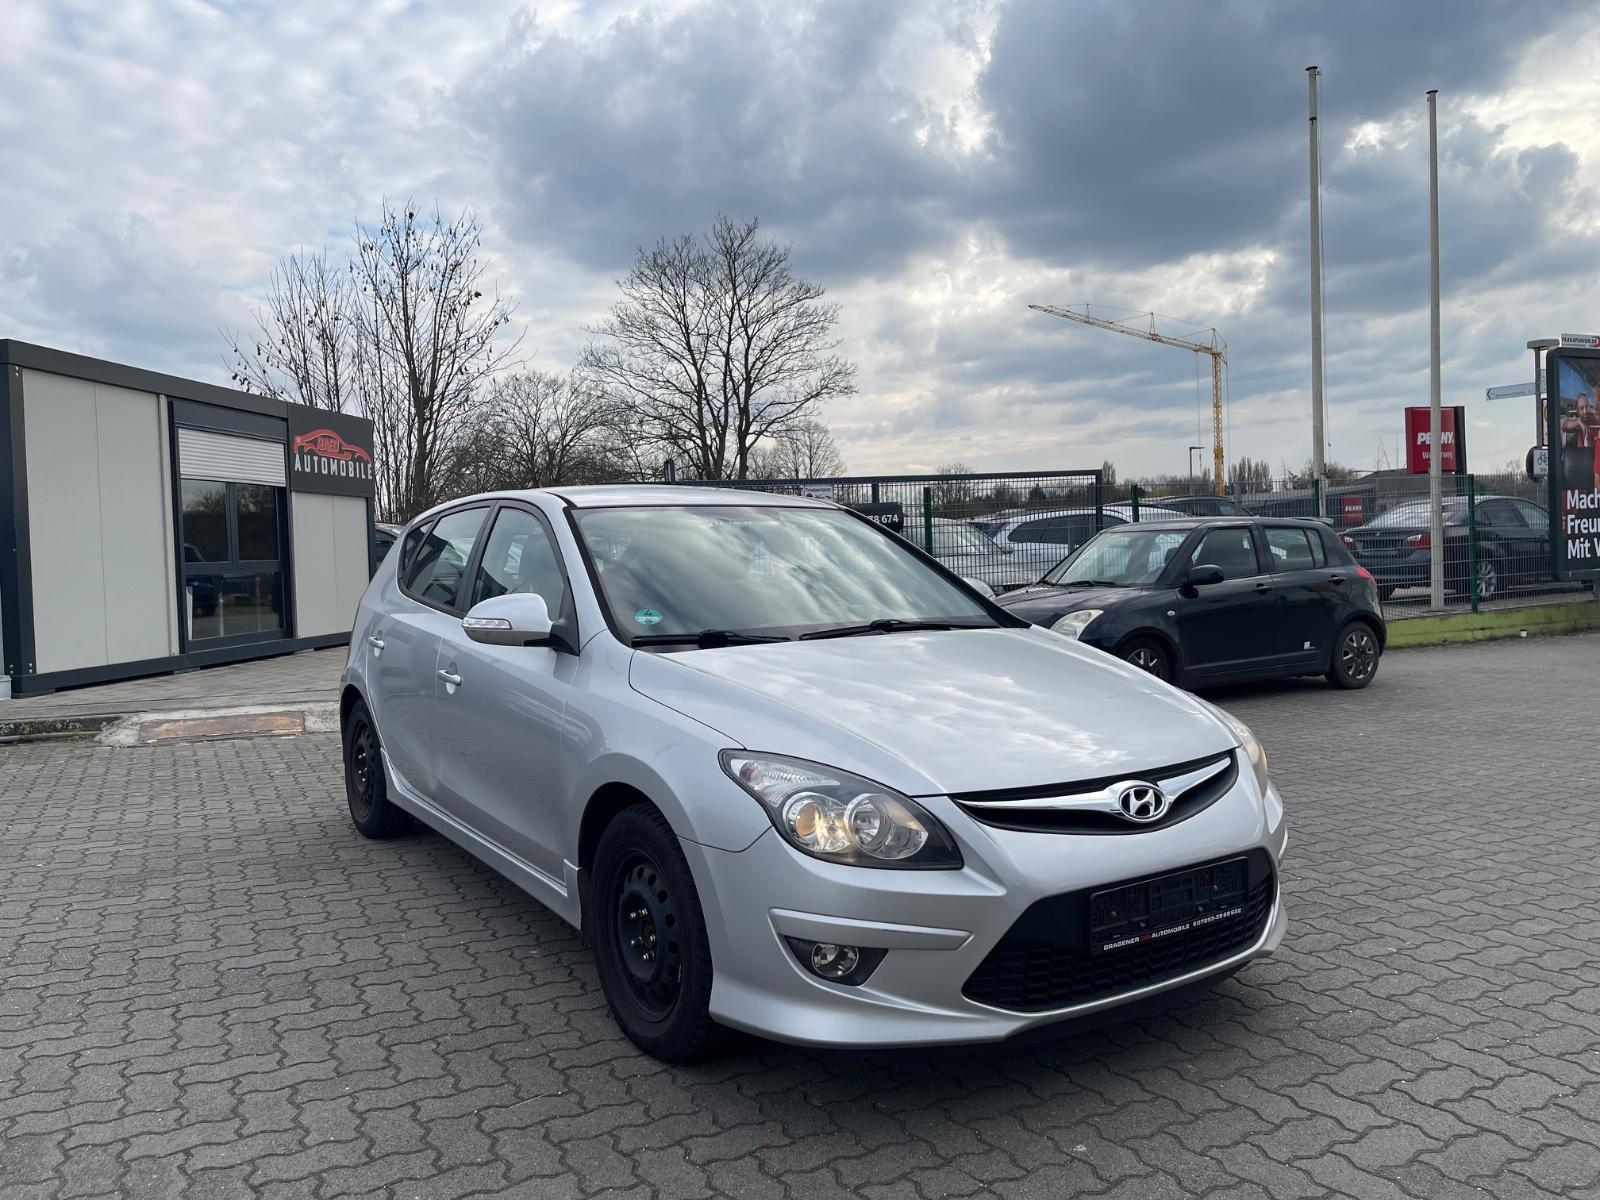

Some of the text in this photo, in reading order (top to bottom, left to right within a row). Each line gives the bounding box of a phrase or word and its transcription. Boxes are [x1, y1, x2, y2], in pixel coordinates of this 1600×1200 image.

[1416, 432, 1454, 445] PENY
[294, 453, 373, 480] AUTOMOBILE
[881, 514, 899, 523] 674
[1567, 537, 1591, 559] Mit
[1151, 923, 1190, 938] AUTOMOBILE
